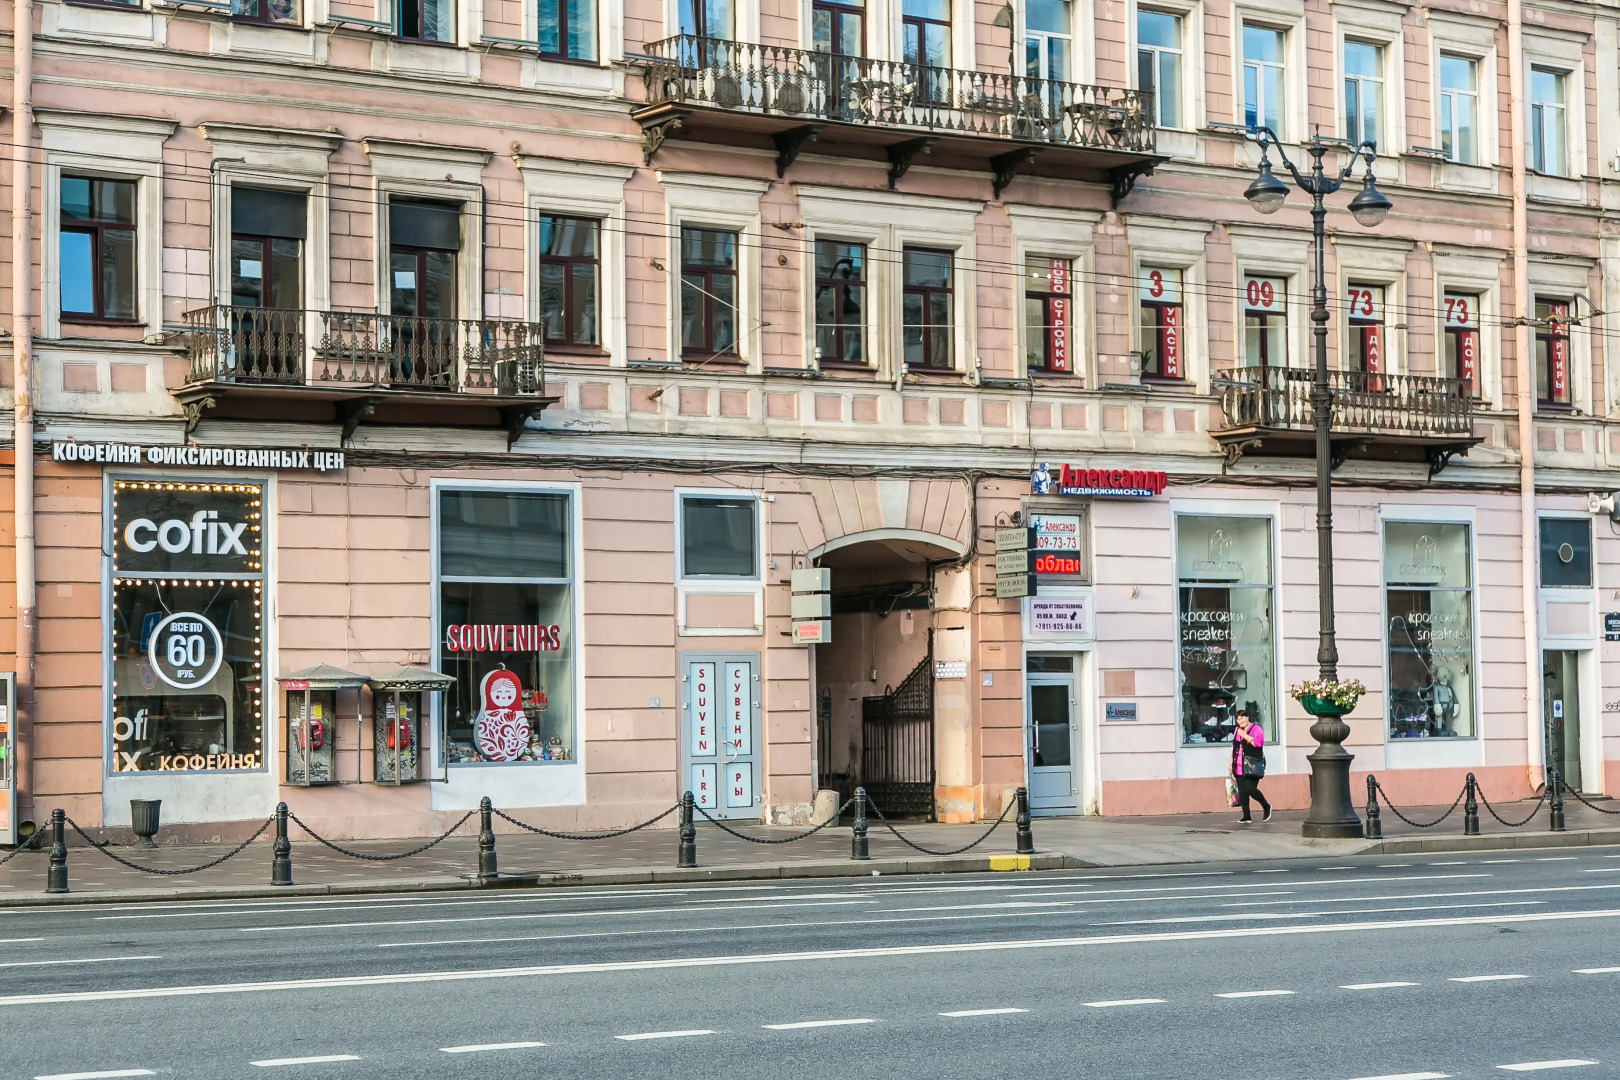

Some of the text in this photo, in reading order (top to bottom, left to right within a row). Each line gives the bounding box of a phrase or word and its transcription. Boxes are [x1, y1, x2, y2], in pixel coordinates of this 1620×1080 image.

[1149, 270, 1163, 298] 3
[1246, 279, 1274, 308] 09
[1347, 289, 1374, 316] 73
[1444, 298, 1469, 324] 73
[1166, 307, 1177, 375] УЧАСТКИ
[1369, 335, 1379, 375] ДАЧ
[1554, 306, 1565, 389] КАРТИРЫ
[1464, 337, 1474, 380] ДОМА
[53, 441, 345, 472] КОФЕЙНЯ ФИКСИРОВАННЫХ ЦЕН
[1060, 463, 1168, 495] Александр
[1062, 487, 1152, 497] НЕДВИЖИМОСТЬ
[124, 510, 249, 556] cofix
[1044, 520, 1077, 535] Александр
[189, 622, 202, 633] ПО
[1182, 611, 1244, 626] кроссовки
[446, 624, 561, 652] SOUVENIRS
[1182, 626, 1236, 641] sneakers
[167, 634, 205, 667] 60
[159, 753, 256, 772] КОФЕЙНЯ
